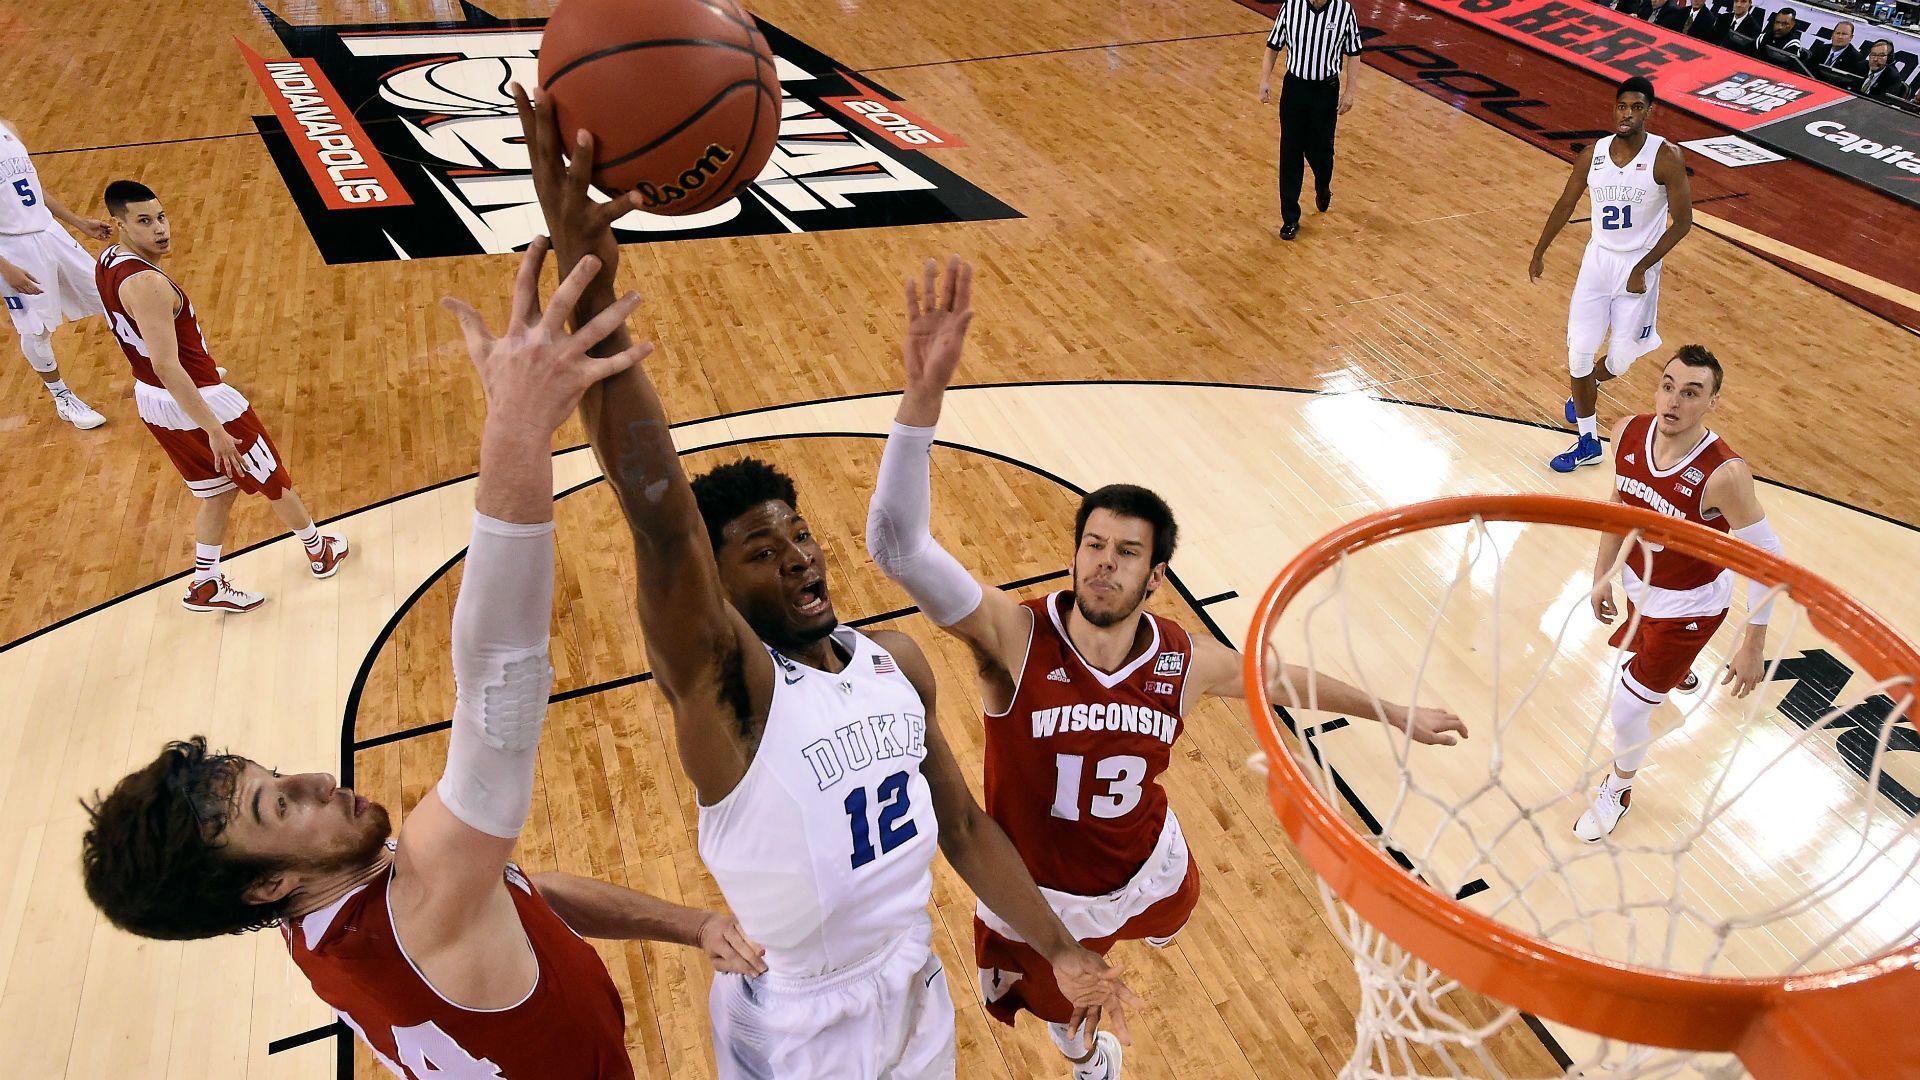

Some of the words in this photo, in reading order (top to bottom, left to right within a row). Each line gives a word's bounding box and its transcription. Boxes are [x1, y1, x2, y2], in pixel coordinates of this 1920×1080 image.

[1501, 2, 1706, 80] HERE
[265, 61, 388, 204] INDIANAPOLIS
[842, 100, 945, 145] 2015
[12, 178, 37, 207] 5
[635, 143, 734, 208] lson
[1594, 185, 1647, 204] DUKE
[1602, 204, 1633, 230] 21
[1046, 673, 1071, 684] adidas
[1031, 702, 1178, 745] WISCONSIN
[802, 712, 926, 791] DUKE
[1050, 753, 1147, 821] 13
[843, 769, 919, 871] 12
